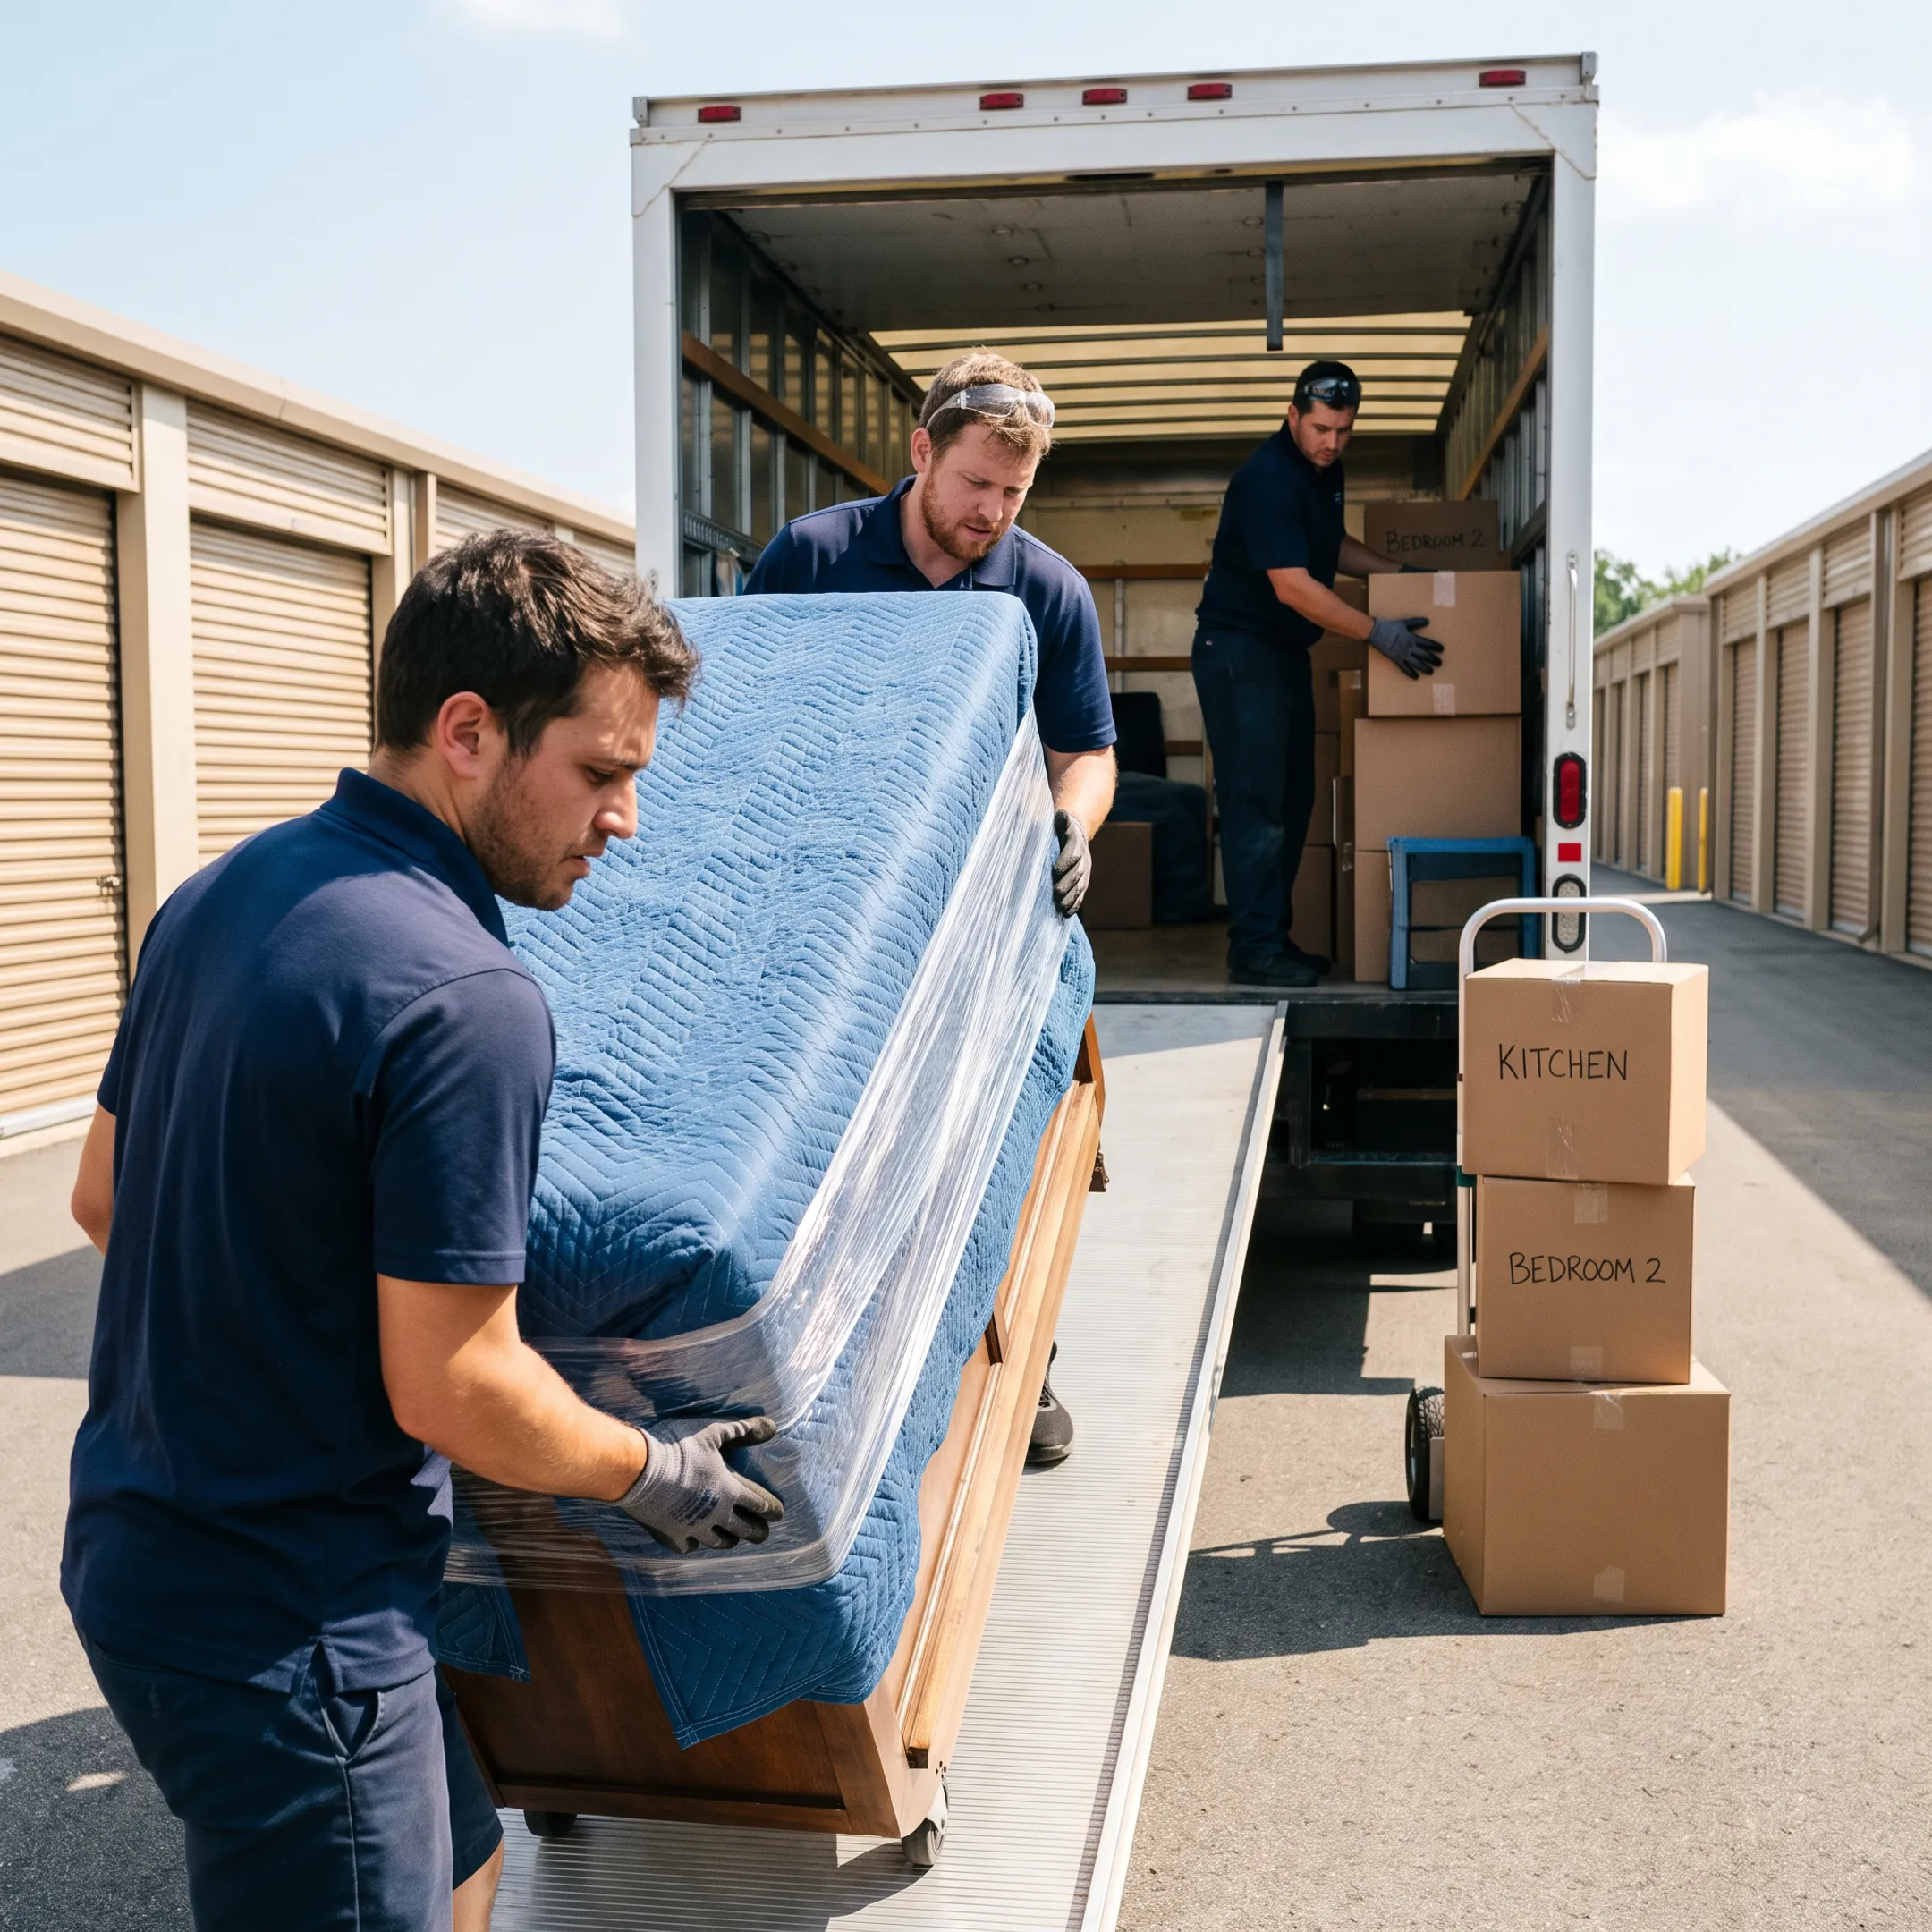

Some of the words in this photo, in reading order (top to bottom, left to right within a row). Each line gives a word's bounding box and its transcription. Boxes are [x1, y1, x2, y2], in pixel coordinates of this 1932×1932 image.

[1386, 530, 1465, 554] BEDROOM
[1470, 528, 1487, 548] 2
[1498, 1043, 1628, 1080] KITCHEN
[1509, 1252, 1635, 1285] BEDROOM
[1645, 1258, 1666, 1284] 2
